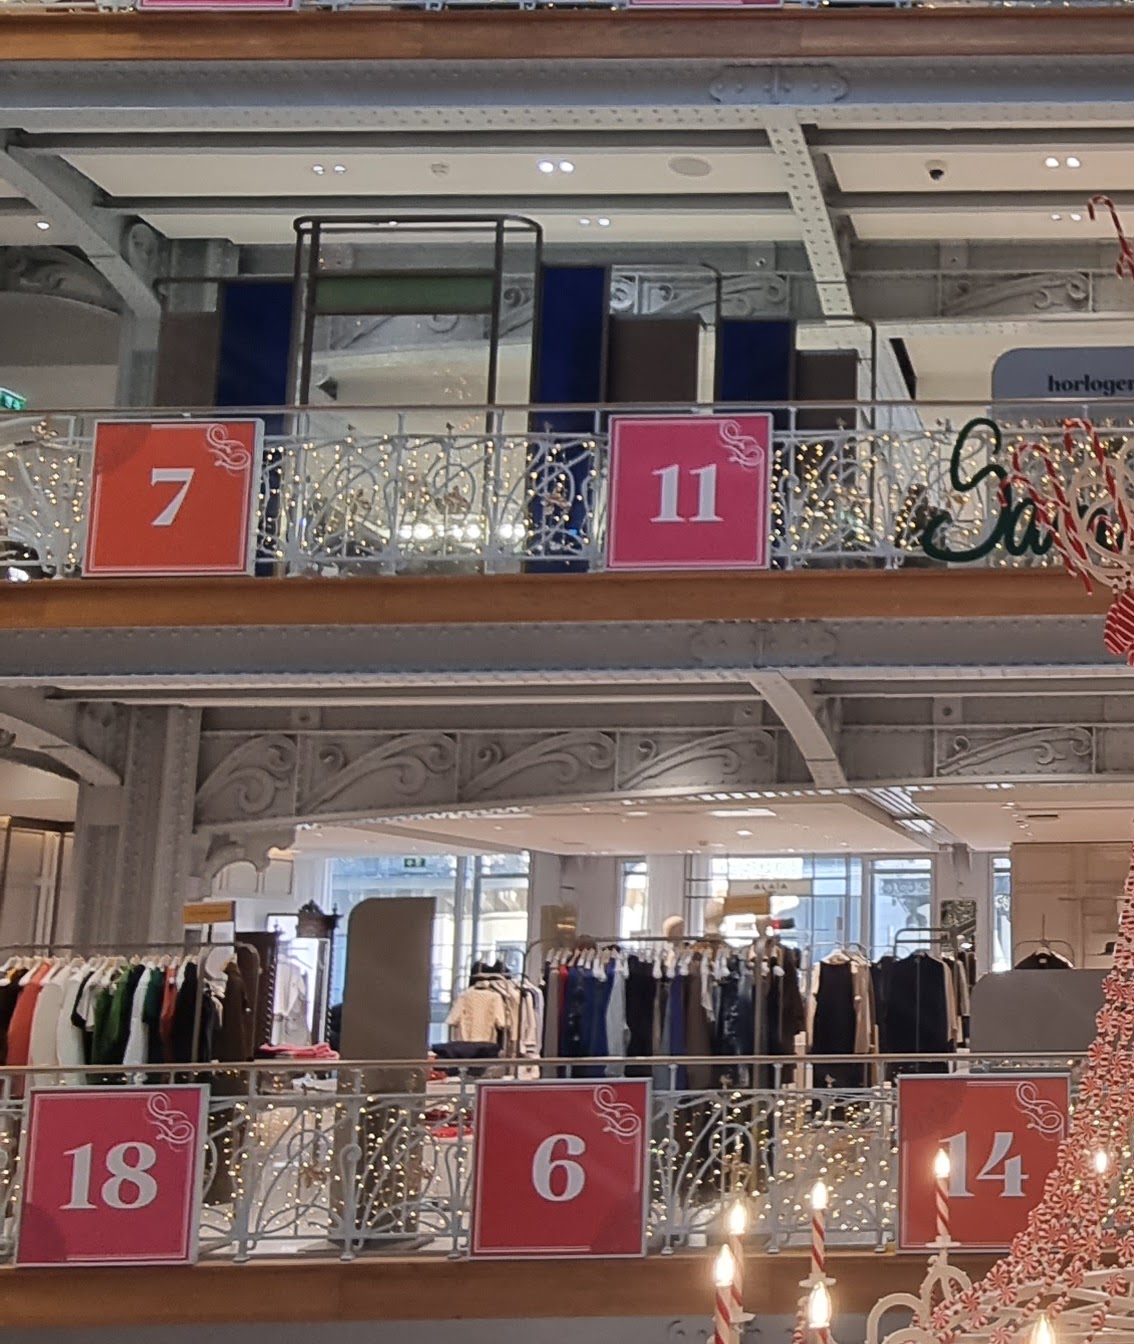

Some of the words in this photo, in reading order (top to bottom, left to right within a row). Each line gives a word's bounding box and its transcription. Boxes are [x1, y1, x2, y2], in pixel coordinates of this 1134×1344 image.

[151, 468, 194, 525] 7
[651, 464, 722, 522] 11
[60, 1142, 157, 1209] 18
[533, 1134, 585, 1201] 6
[940, 1131, 1029, 1197] 14
